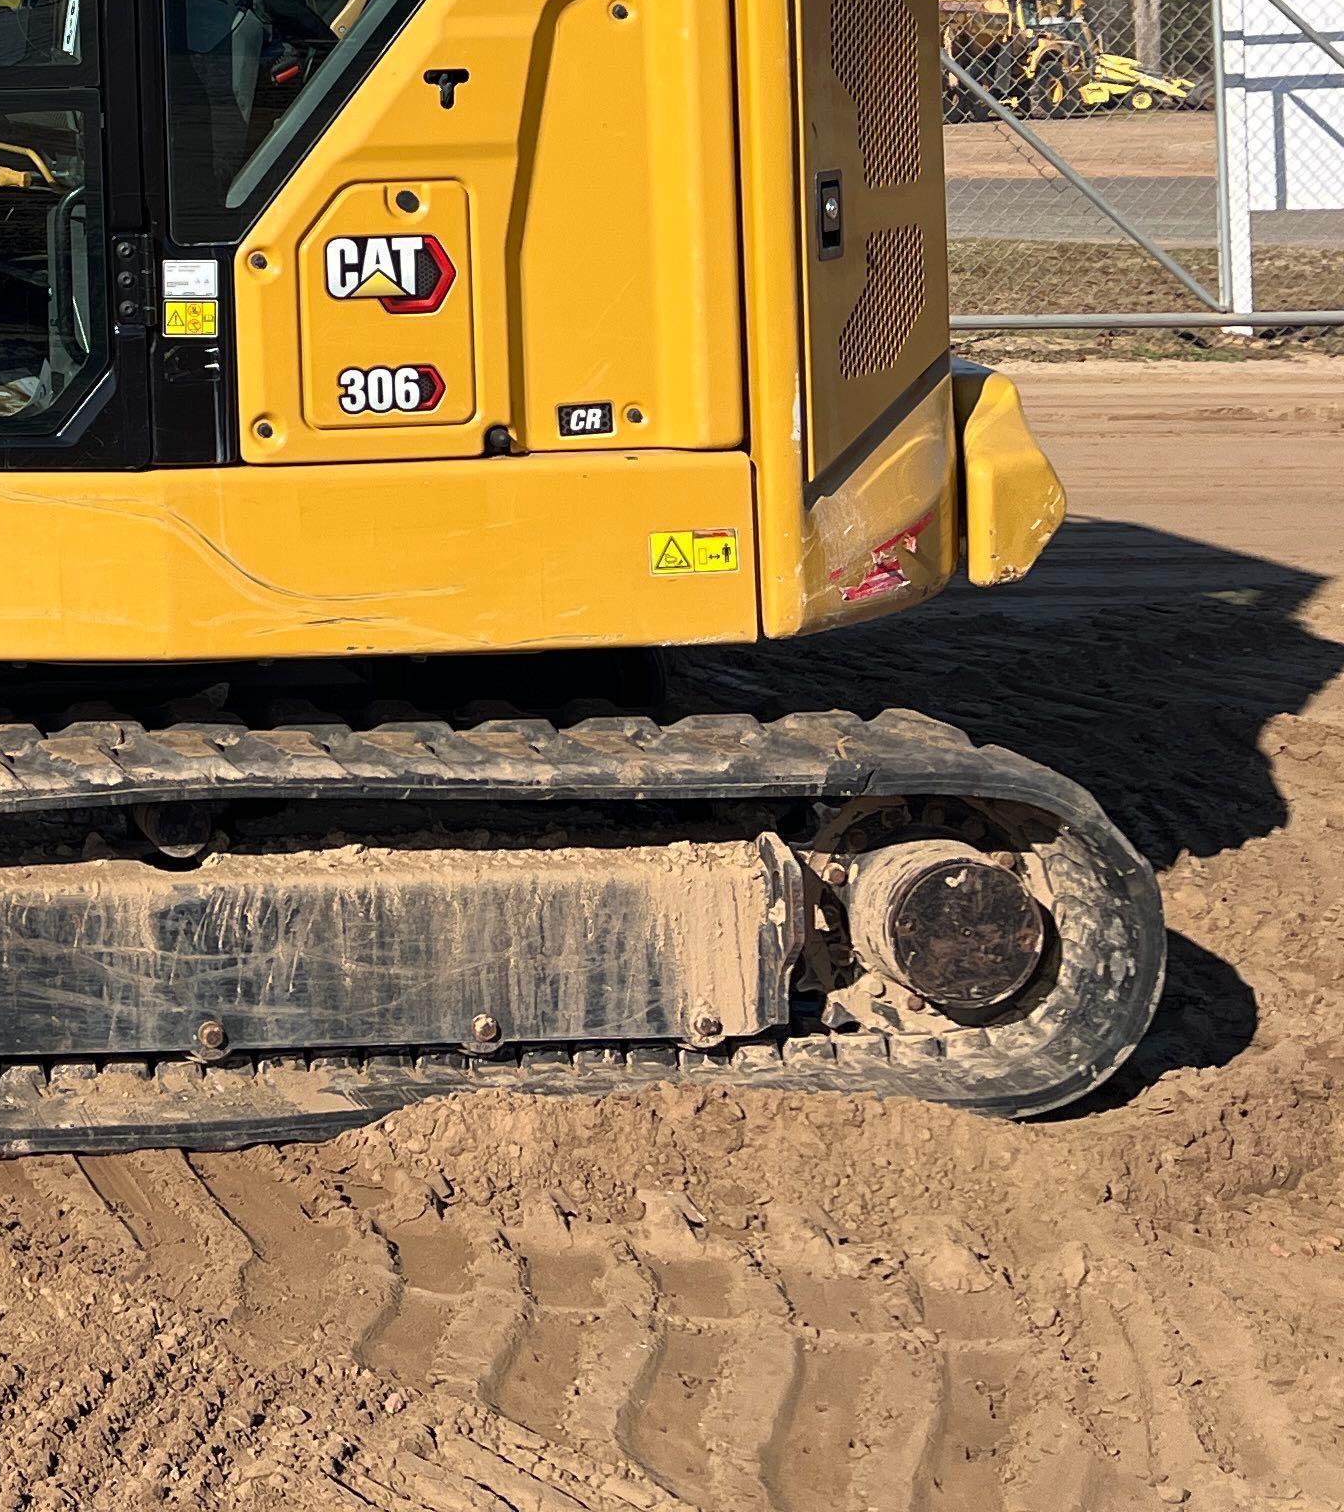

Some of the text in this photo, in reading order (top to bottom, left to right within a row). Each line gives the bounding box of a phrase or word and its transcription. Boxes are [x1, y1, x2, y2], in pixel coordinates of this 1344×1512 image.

[326, 237, 423, 297] CAT
[340, 367, 420, 411] 306
[570, 408, 602, 430] CR
